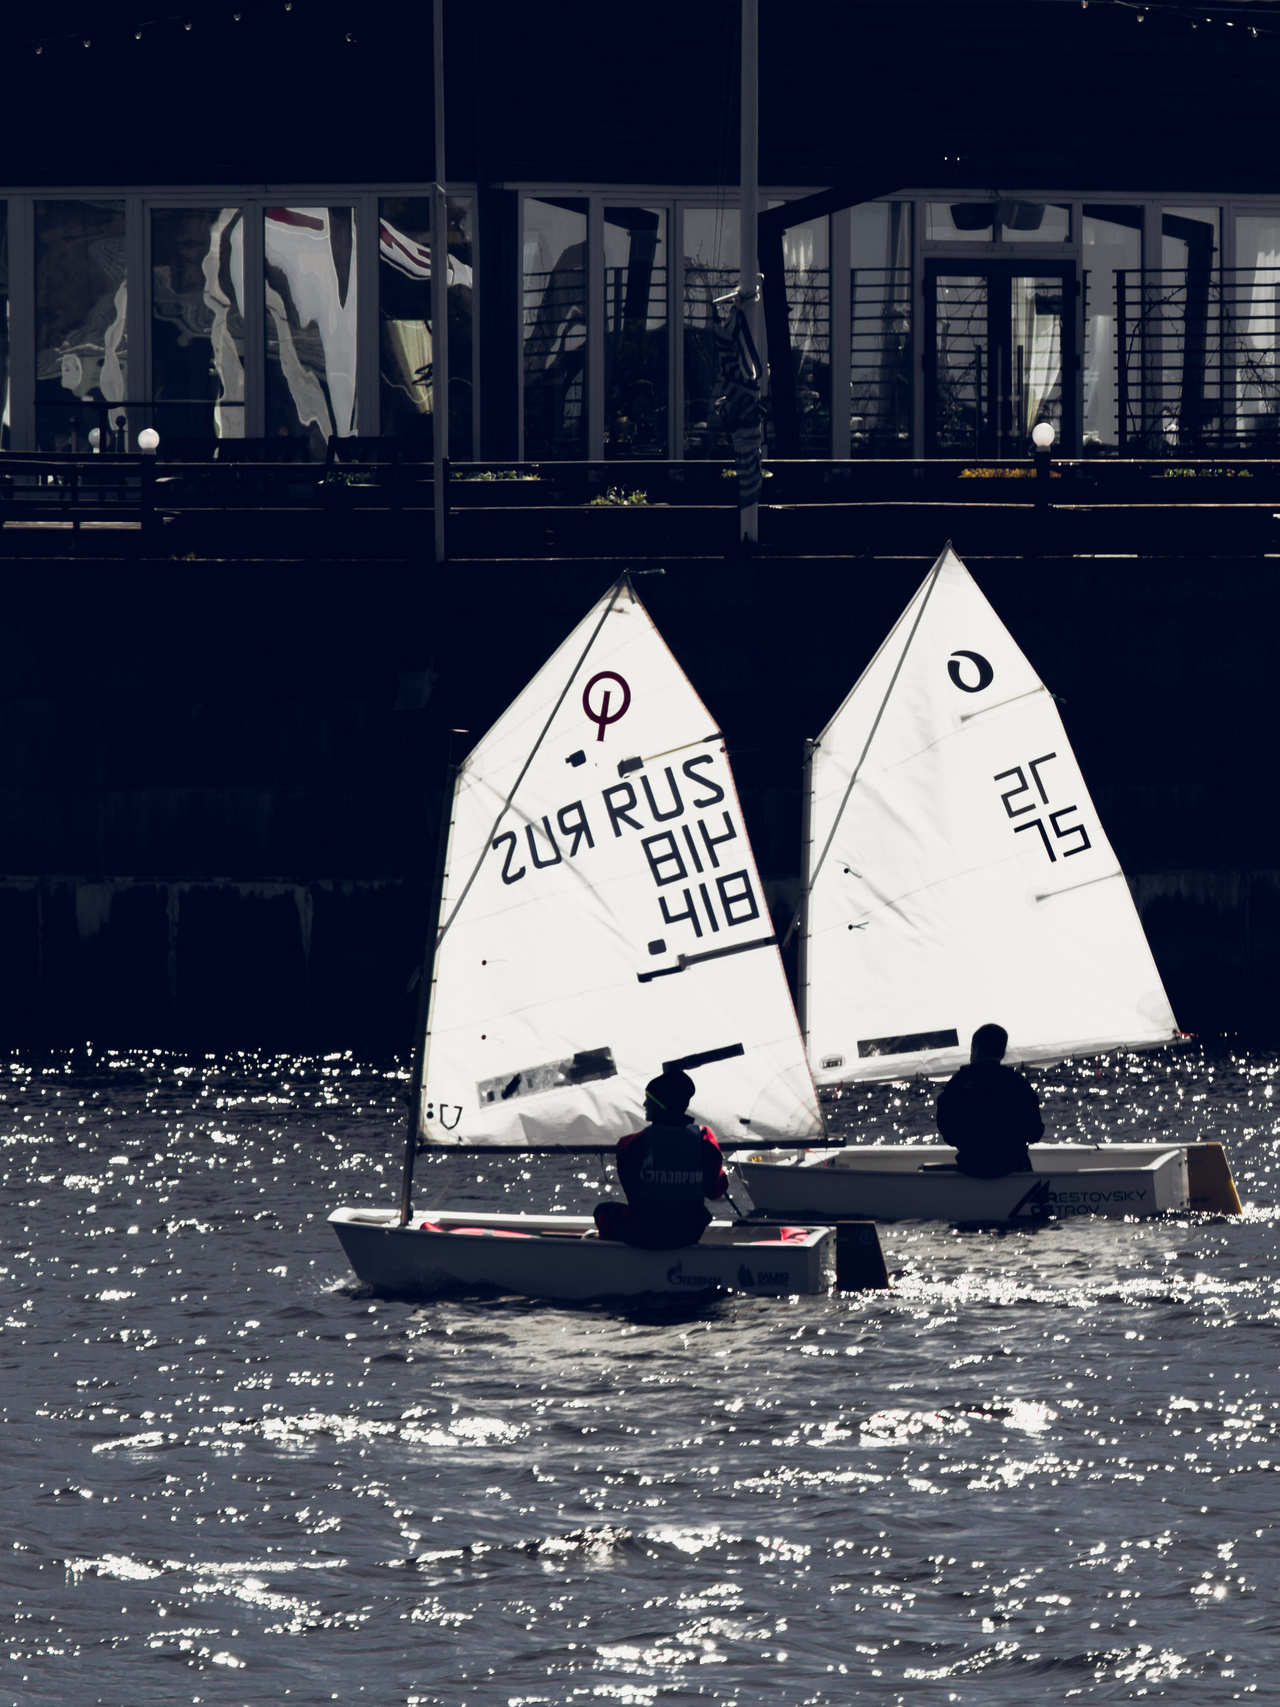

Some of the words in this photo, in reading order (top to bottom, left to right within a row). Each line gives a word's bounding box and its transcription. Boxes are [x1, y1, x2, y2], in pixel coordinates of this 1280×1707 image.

[602, 755, 724, 837] RUS
[1014, 805, 1091, 862] 75
[658, 869, 759, 937] 418
[655, 1169, 704, 1185] ГАЗПРОМ
